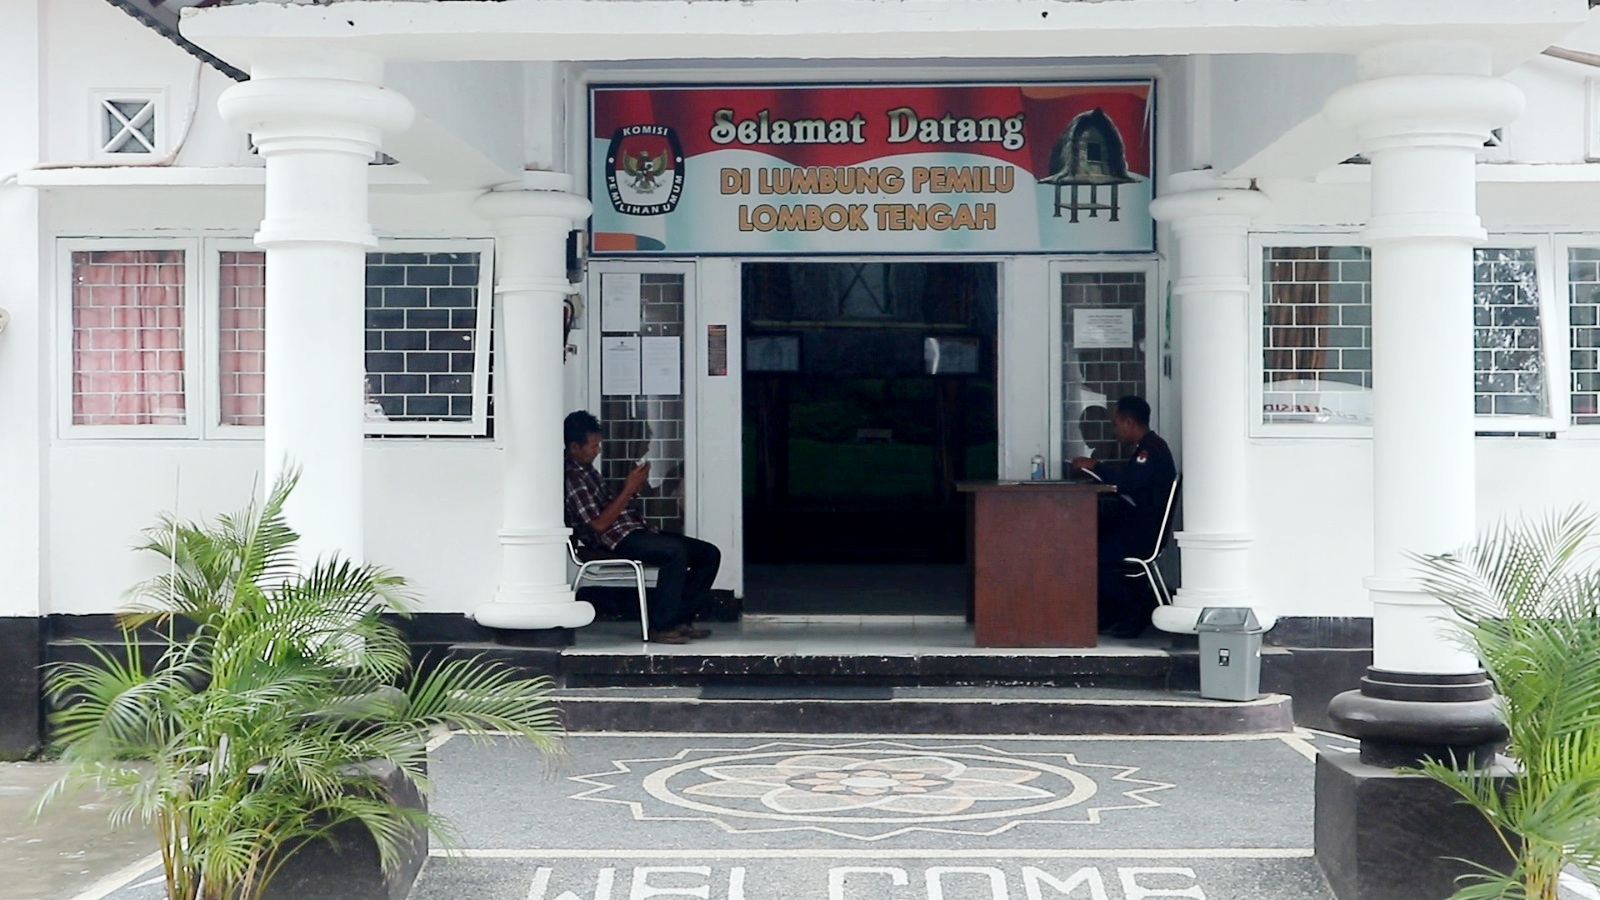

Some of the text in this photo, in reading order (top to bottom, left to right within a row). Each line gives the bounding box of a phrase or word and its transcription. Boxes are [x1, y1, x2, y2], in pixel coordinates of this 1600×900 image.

[622, 125, 669, 137] KOMISI
[709, 107, 1025, 151] Selamat Datang
[607, 175, 684, 214] PEMILIHAN UMUM
[720, 165, 1015, 195] DI LUMBUNG PEMILU
[738, 203, 996, 232] LOMBOK TENGAH
